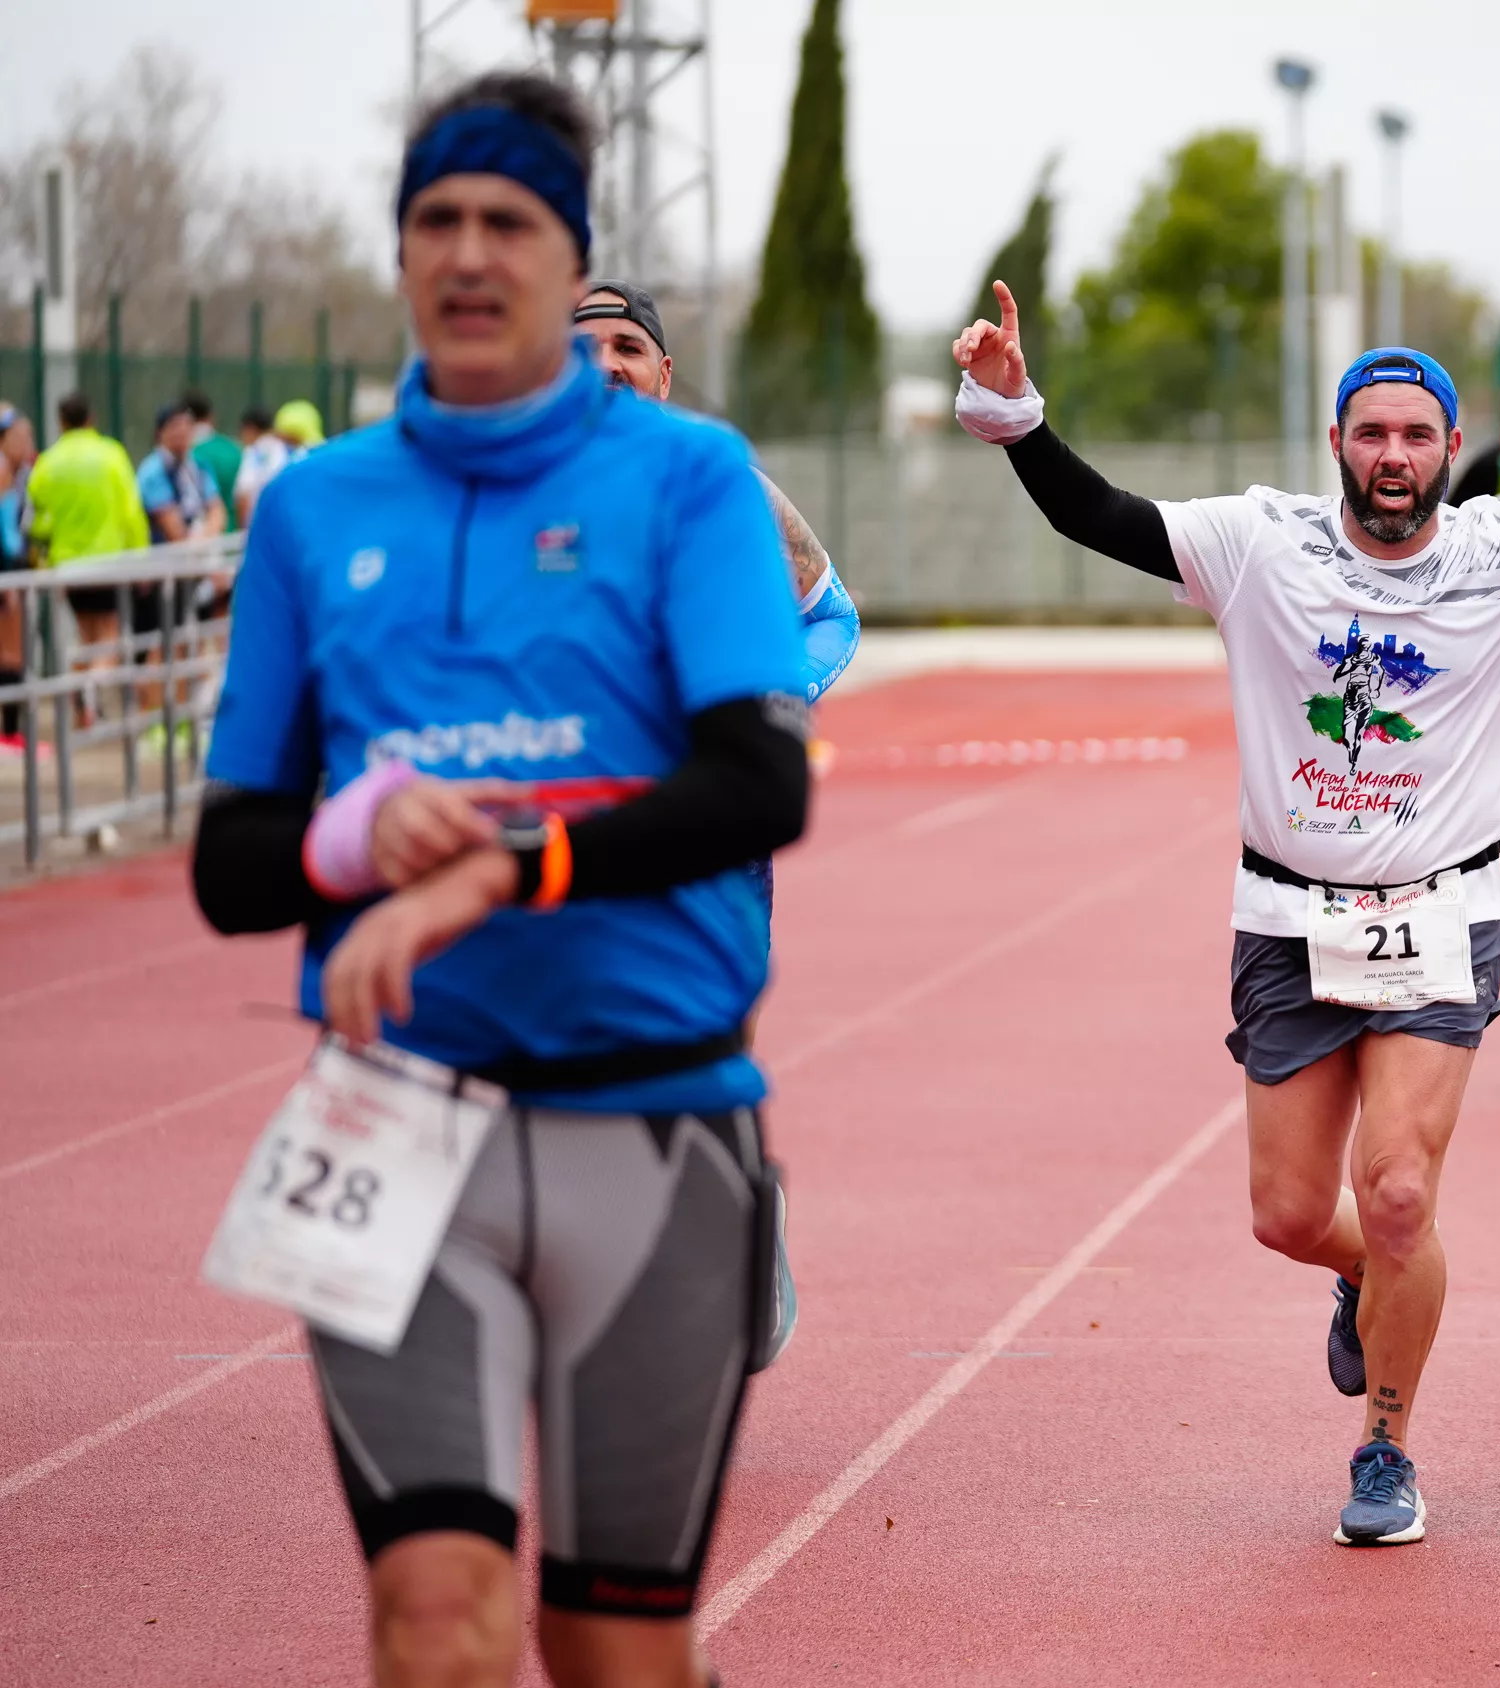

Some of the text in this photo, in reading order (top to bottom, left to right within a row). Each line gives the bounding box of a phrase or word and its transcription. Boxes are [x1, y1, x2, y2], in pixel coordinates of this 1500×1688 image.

[821, 655, 846, 691] ZURICH
[1316, 786, 1402, 813] LUCENA
[1364, 921, 1420, 961] 21
